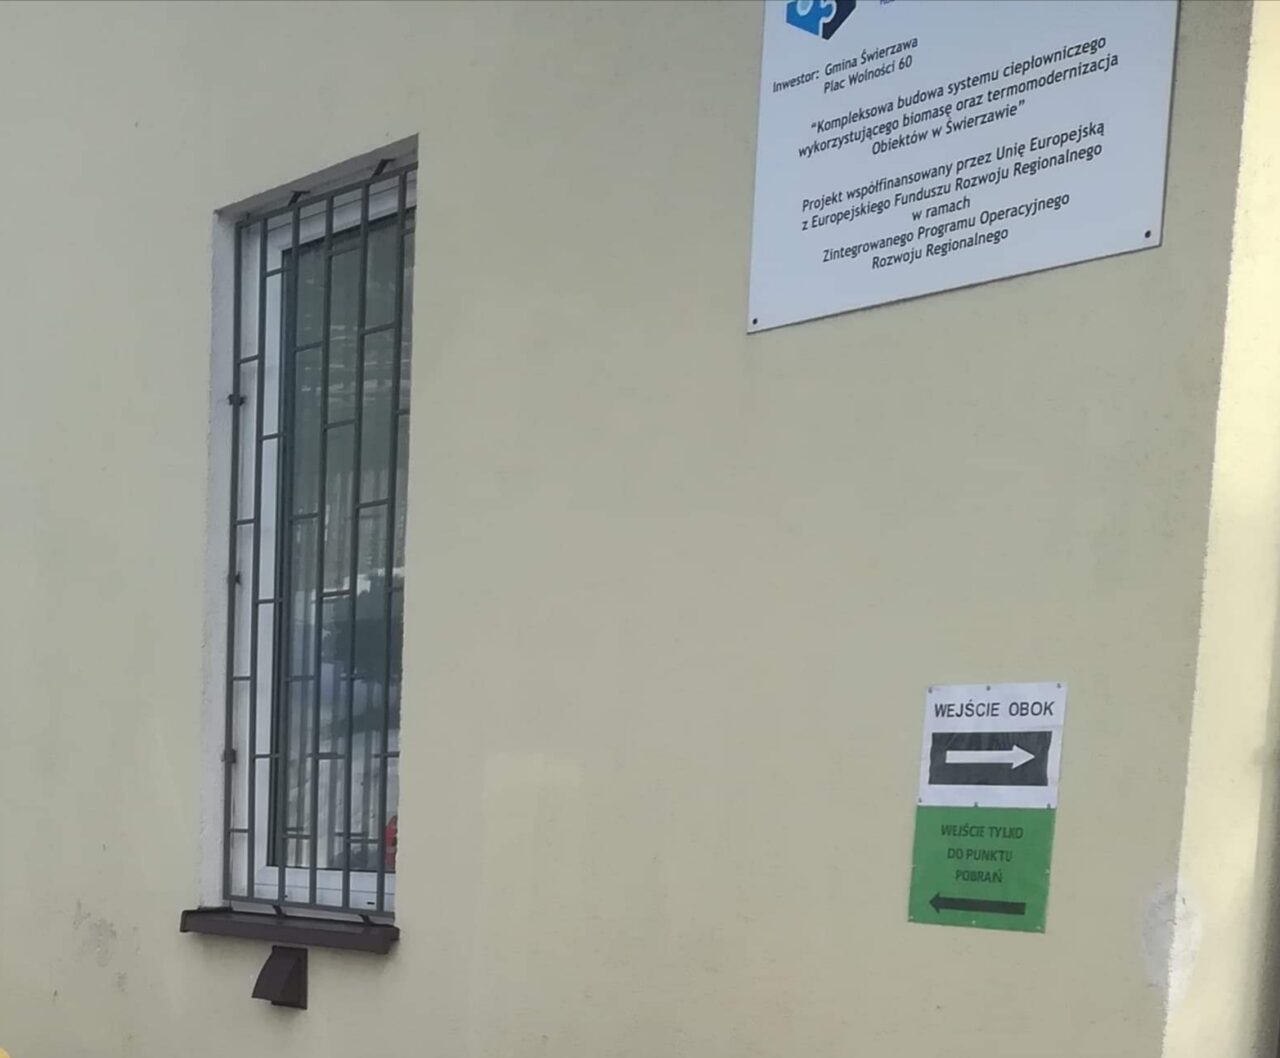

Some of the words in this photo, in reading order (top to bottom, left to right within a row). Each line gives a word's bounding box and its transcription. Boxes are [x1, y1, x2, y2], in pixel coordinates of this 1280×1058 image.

[773, 69, 820, 93] Inwestor:
[825, 57, 858, 76] Gmina
[860, 37, 918, 65] Świerzawa
[824, 77, 845, 94] Plac
[848, 60, 895, 84] Wolności
[899, 55, 913, 71] 60
[897, 85, 944, 110] budowa
[947, 69, 999, 96] systemu
[1003, 36, 1106, 78] ciepłowniczego
[798, 115, 899, 158] wykorzystującego
[902, 102, 952, 127] biomasę
[956, 94, 983, 112] oraz
[987, 53, 1119, 103] termomodernizacja
[872, 127, 928, 155] Obiektów
[932, 126, 943, 139] w
[802, 190, 843, 212] Projekt
[846, 162, 952, 201] współfinansowany
[956, 151, 992, 174] przez
[996, 141, 1025, 161] Unię
[1030, 121, 1105, 152] Europejską
[802, 219, 809, 231] z
[811, 198, 891, 229] Europejskiego
[894, 182, 951, 207] Funduszu
[955, 167, 1009, 192] Rozwoju
[1013, 143, 1102, 176] Regionalnego
[823, 230, 914, 263] Zintegrowanego
[918, 215, 976, 240] Programu
[979, 193, 1070, 226] Operacyjnego
[912, 210, 922, 222] w
[925, 196, 970, 219] ramach
[872, 246, 922, 269] Rozwoju
[926, 228, 1009, 258] Regionalnego
[934, 699, 1000, 717] WEJŚCIE
[1008, 701, 1055, 716] OBOK
[941, 824, 985, 838] WEJŚCIE
[988, 825, 1024, 839] TYLKO
[947, 848, 964, 860] DO
[967, 848, 1012, 862] PUNKTU
